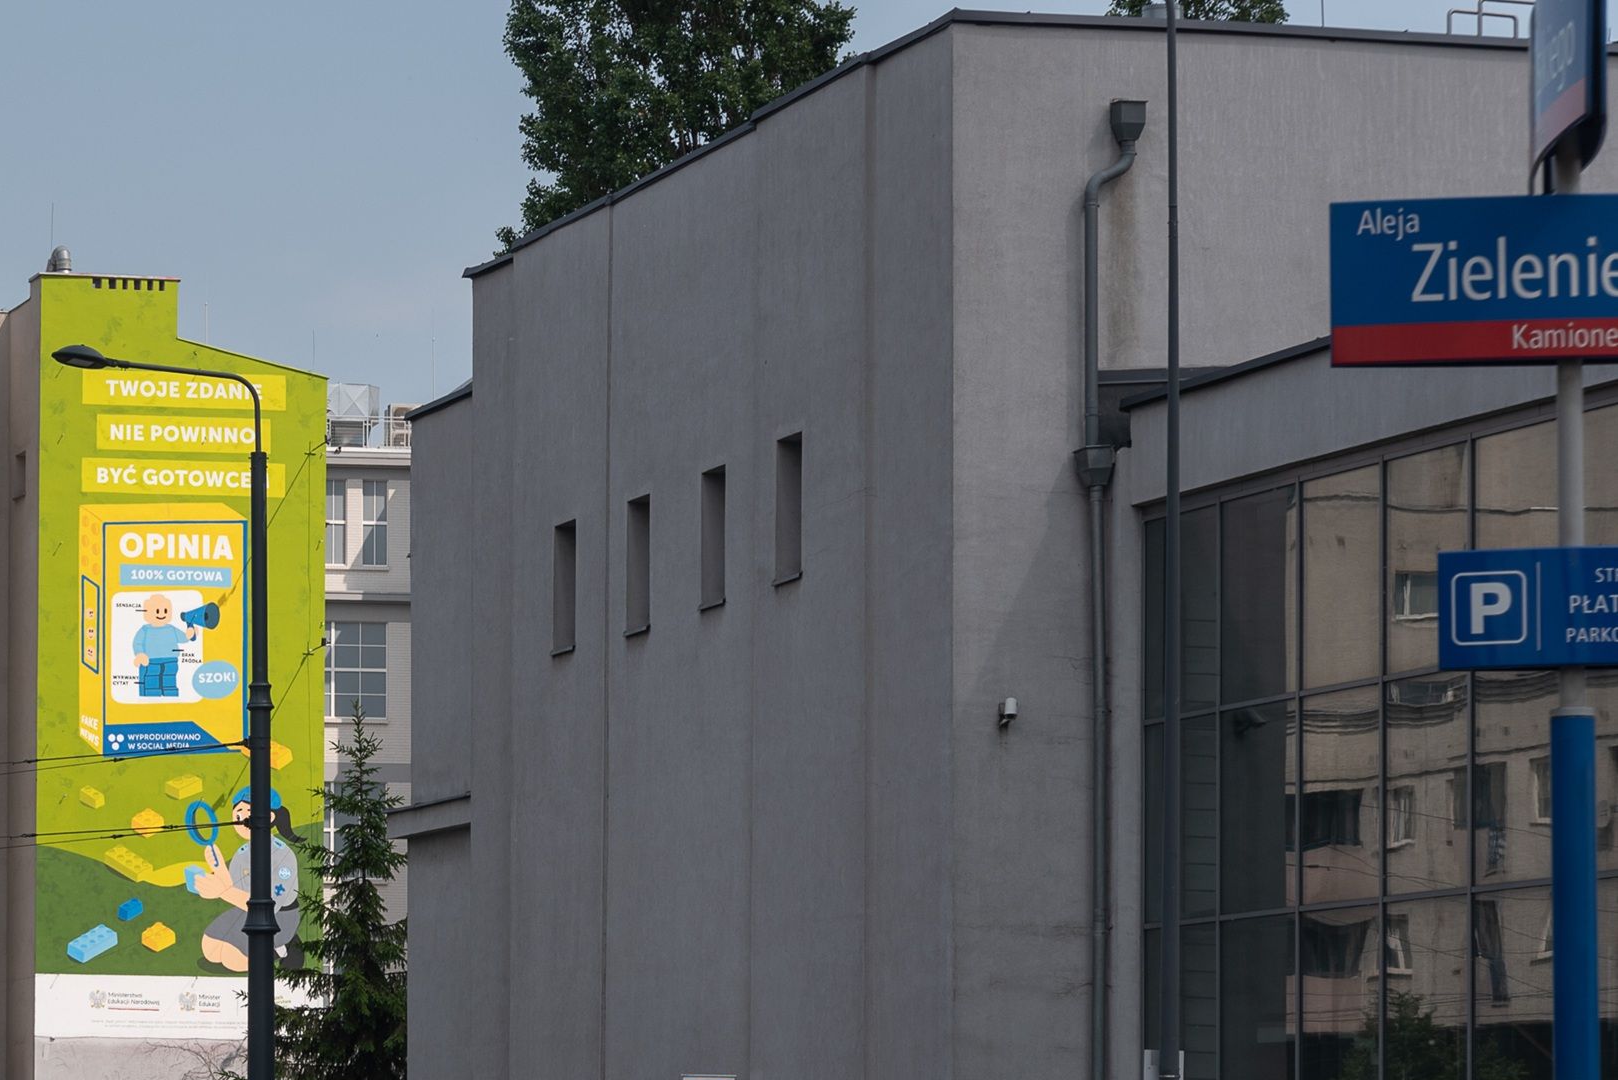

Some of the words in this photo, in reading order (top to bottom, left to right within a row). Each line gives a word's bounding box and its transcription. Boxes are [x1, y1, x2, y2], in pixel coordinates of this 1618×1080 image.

[1356, 208, 1420, 242] Aleja
[1512, 322, 1618, 350] Kamione
[106, 379, 181, 398] TWOJE
[110, 424, 144, 441] NIE
[150, 425, 256, 445] POWINNO
[96, 464, 137, 485] BYĆ
[142, 469, 270, 489] GOTOWCE
[119, 532, 234, 560] OPINIA
[131, 569, 164, 581] 100%
[166, 570, 223, 581] GOTOWA
[1470, 582, 1512, 635] P
[198, 672, 236, 684] SZOK!
[81, 714, 99, 731] FAKE
[80, 726, 100, 748] NEWS
[127, 733, 202, 742] WYPRODUKOWANO
[127, 742, 136, 750] W
[137, 742, 165, 750] SOCIAL
